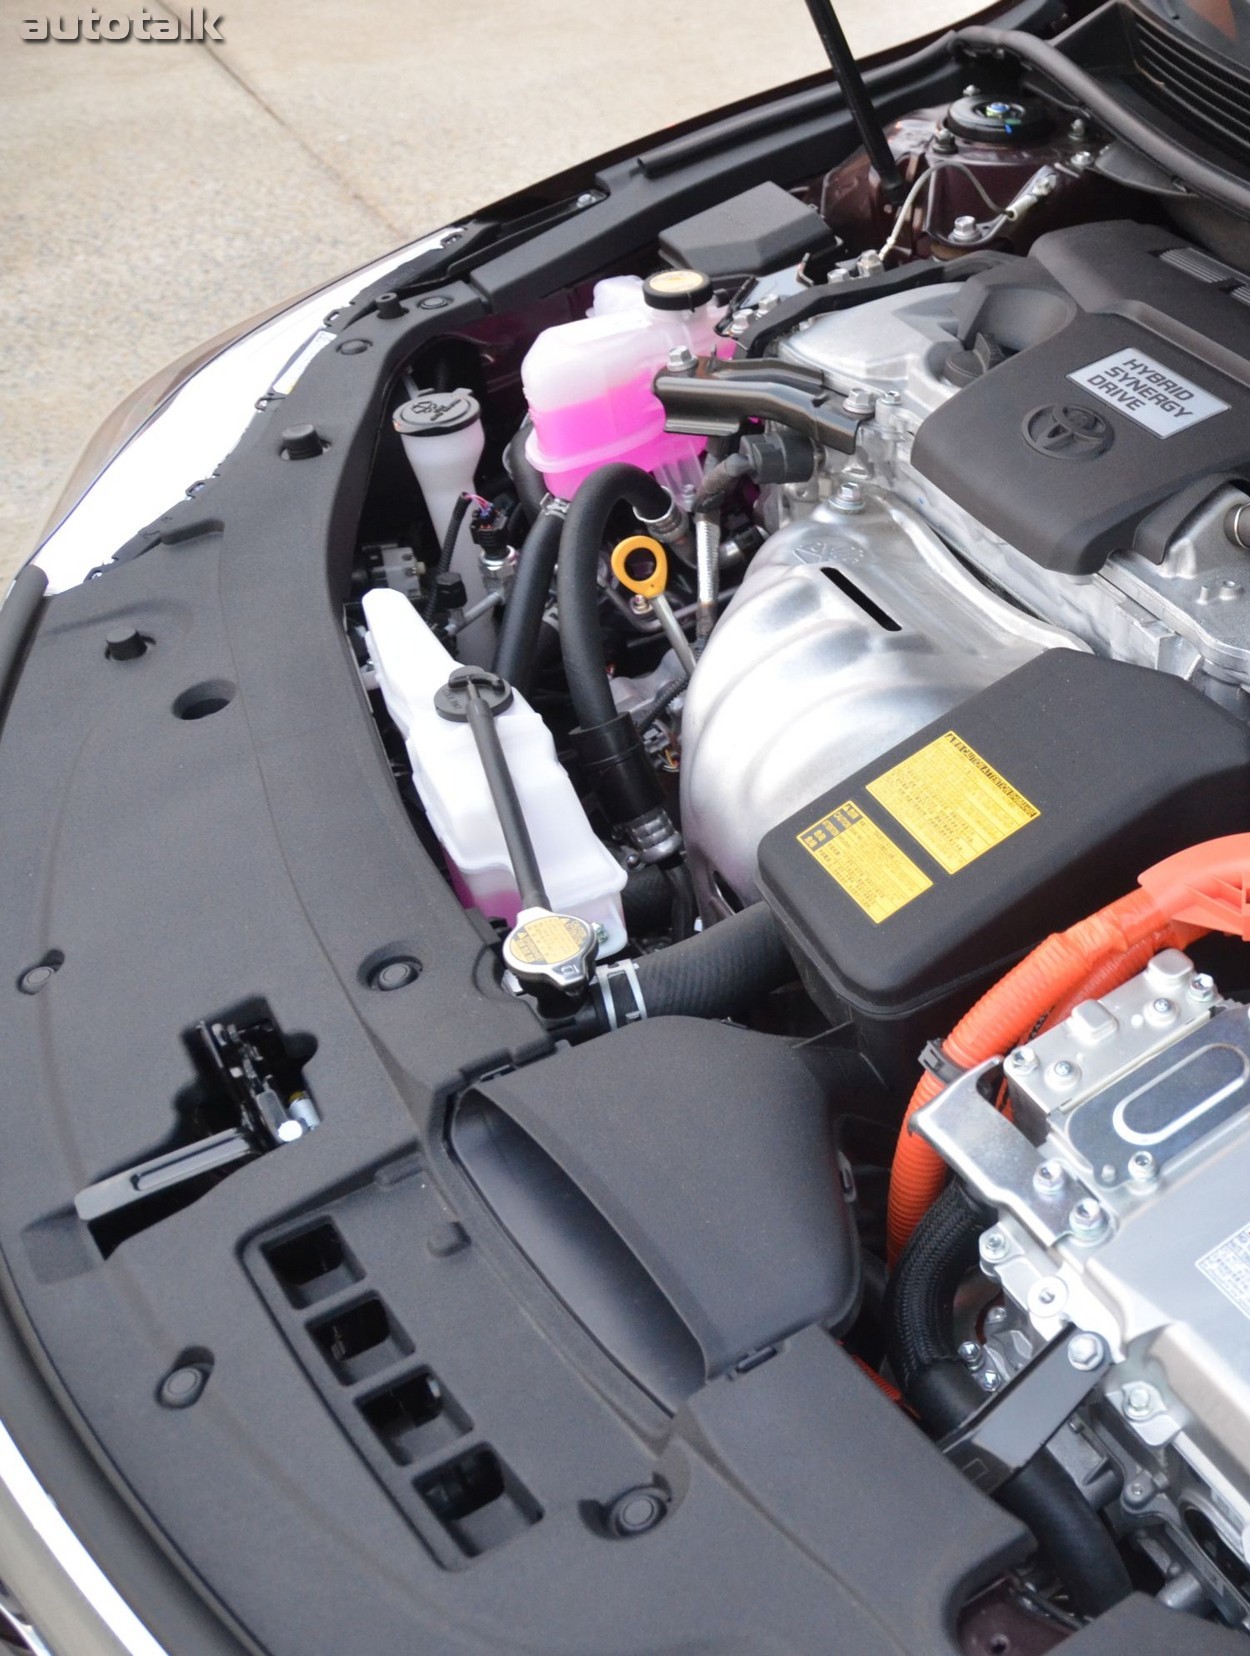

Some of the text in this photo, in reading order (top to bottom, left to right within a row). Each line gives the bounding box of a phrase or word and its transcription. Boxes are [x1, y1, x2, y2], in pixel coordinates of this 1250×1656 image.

[1087, 374, 1146, 412] DRIVE
[1104, 366, 1193, 419] SYNERGY
[1123, 358, 1194, 401] HYBRID
